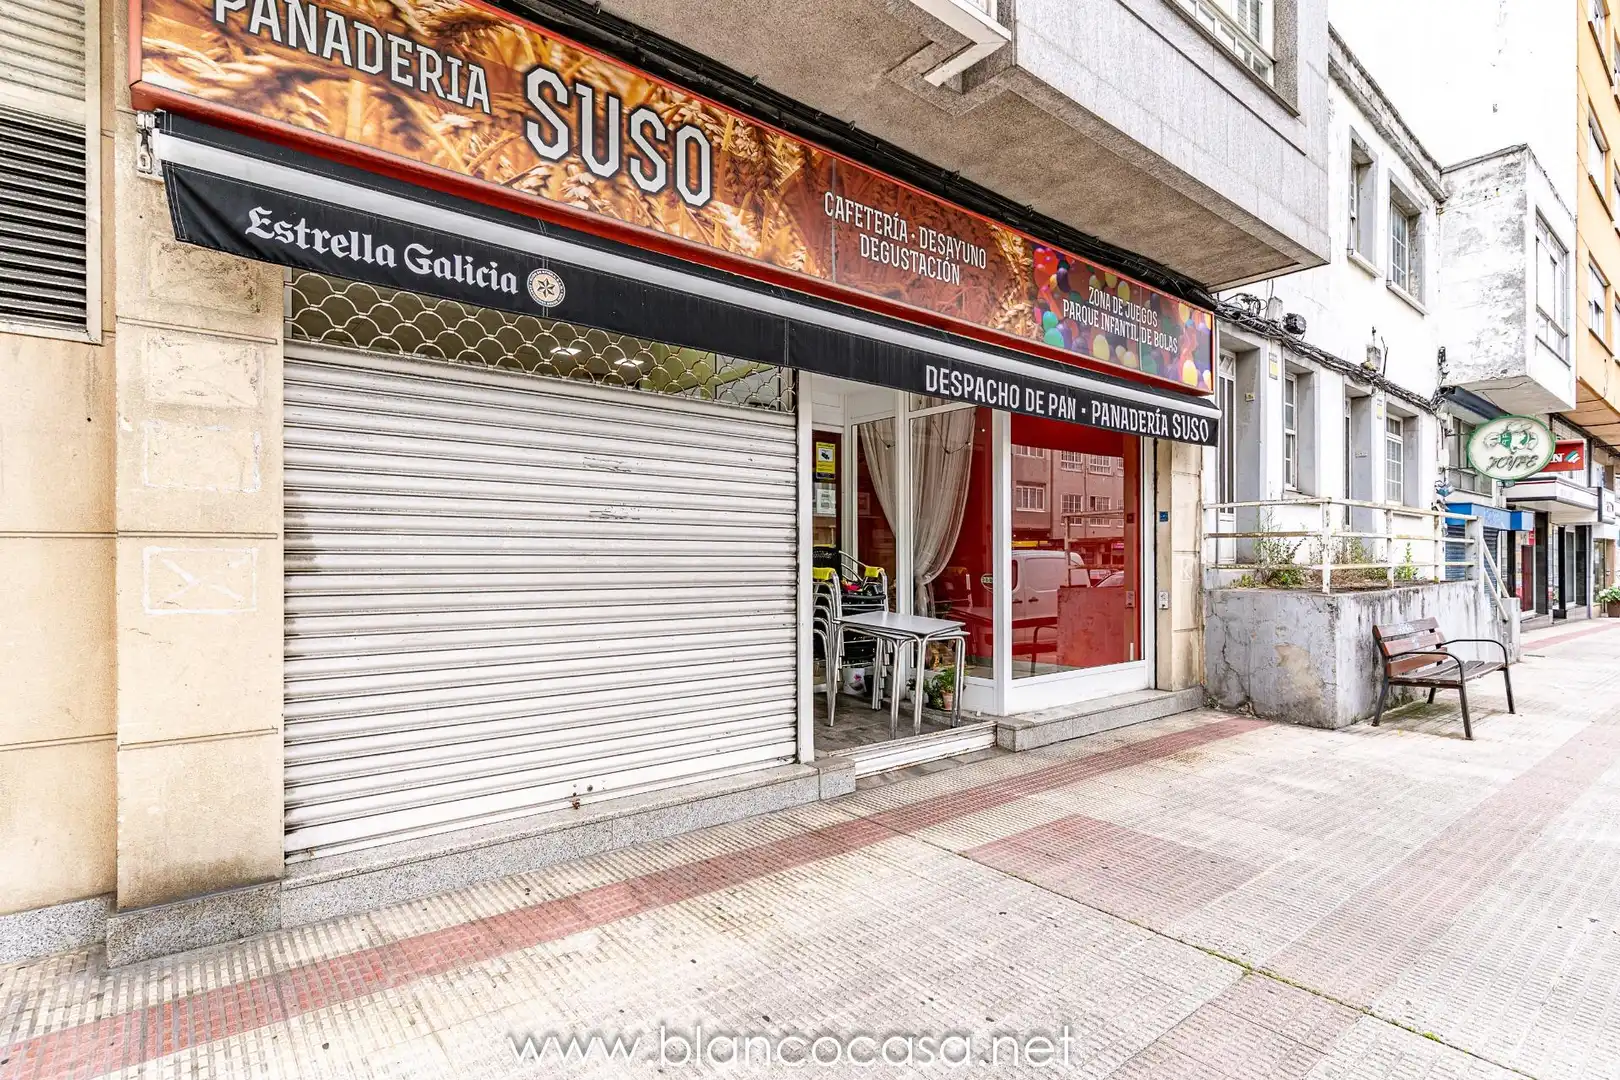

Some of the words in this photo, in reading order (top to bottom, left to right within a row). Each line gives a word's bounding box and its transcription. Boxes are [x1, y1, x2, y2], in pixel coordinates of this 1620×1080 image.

[526, 67, 712, 208] SUSO
[245, 206, 398, 268] Estrella
[403, 243, 519, 295] Galicia
[824, 191, 908, 243] CAFETERÍA
[918, 226, 987, 270] DESAYUNO
[859, 233, 960, 286] DEGUSTACIÓN
[1062, 298, 1099, 328] PARQUE
[1100, 312, 1139, 342] INFANTIL
[1141, 326, 1152, 345] DE
[1153, 330, 1178, 354] BOLAS
[1088, 286, 1111, 311] ZONA
[1112, 295, 1124, 316] DE
[1124, 302, 1158, 328] JUEGOS
[925, 364, 1020, 410] DESPACHO
[1025, 387, 1045, 414] DE
[1048, 393, 1077, 420] PAN
[1091, 400, 1170, 437] PANADERÍA
[1172, 413, 1209, 443] SUSO
